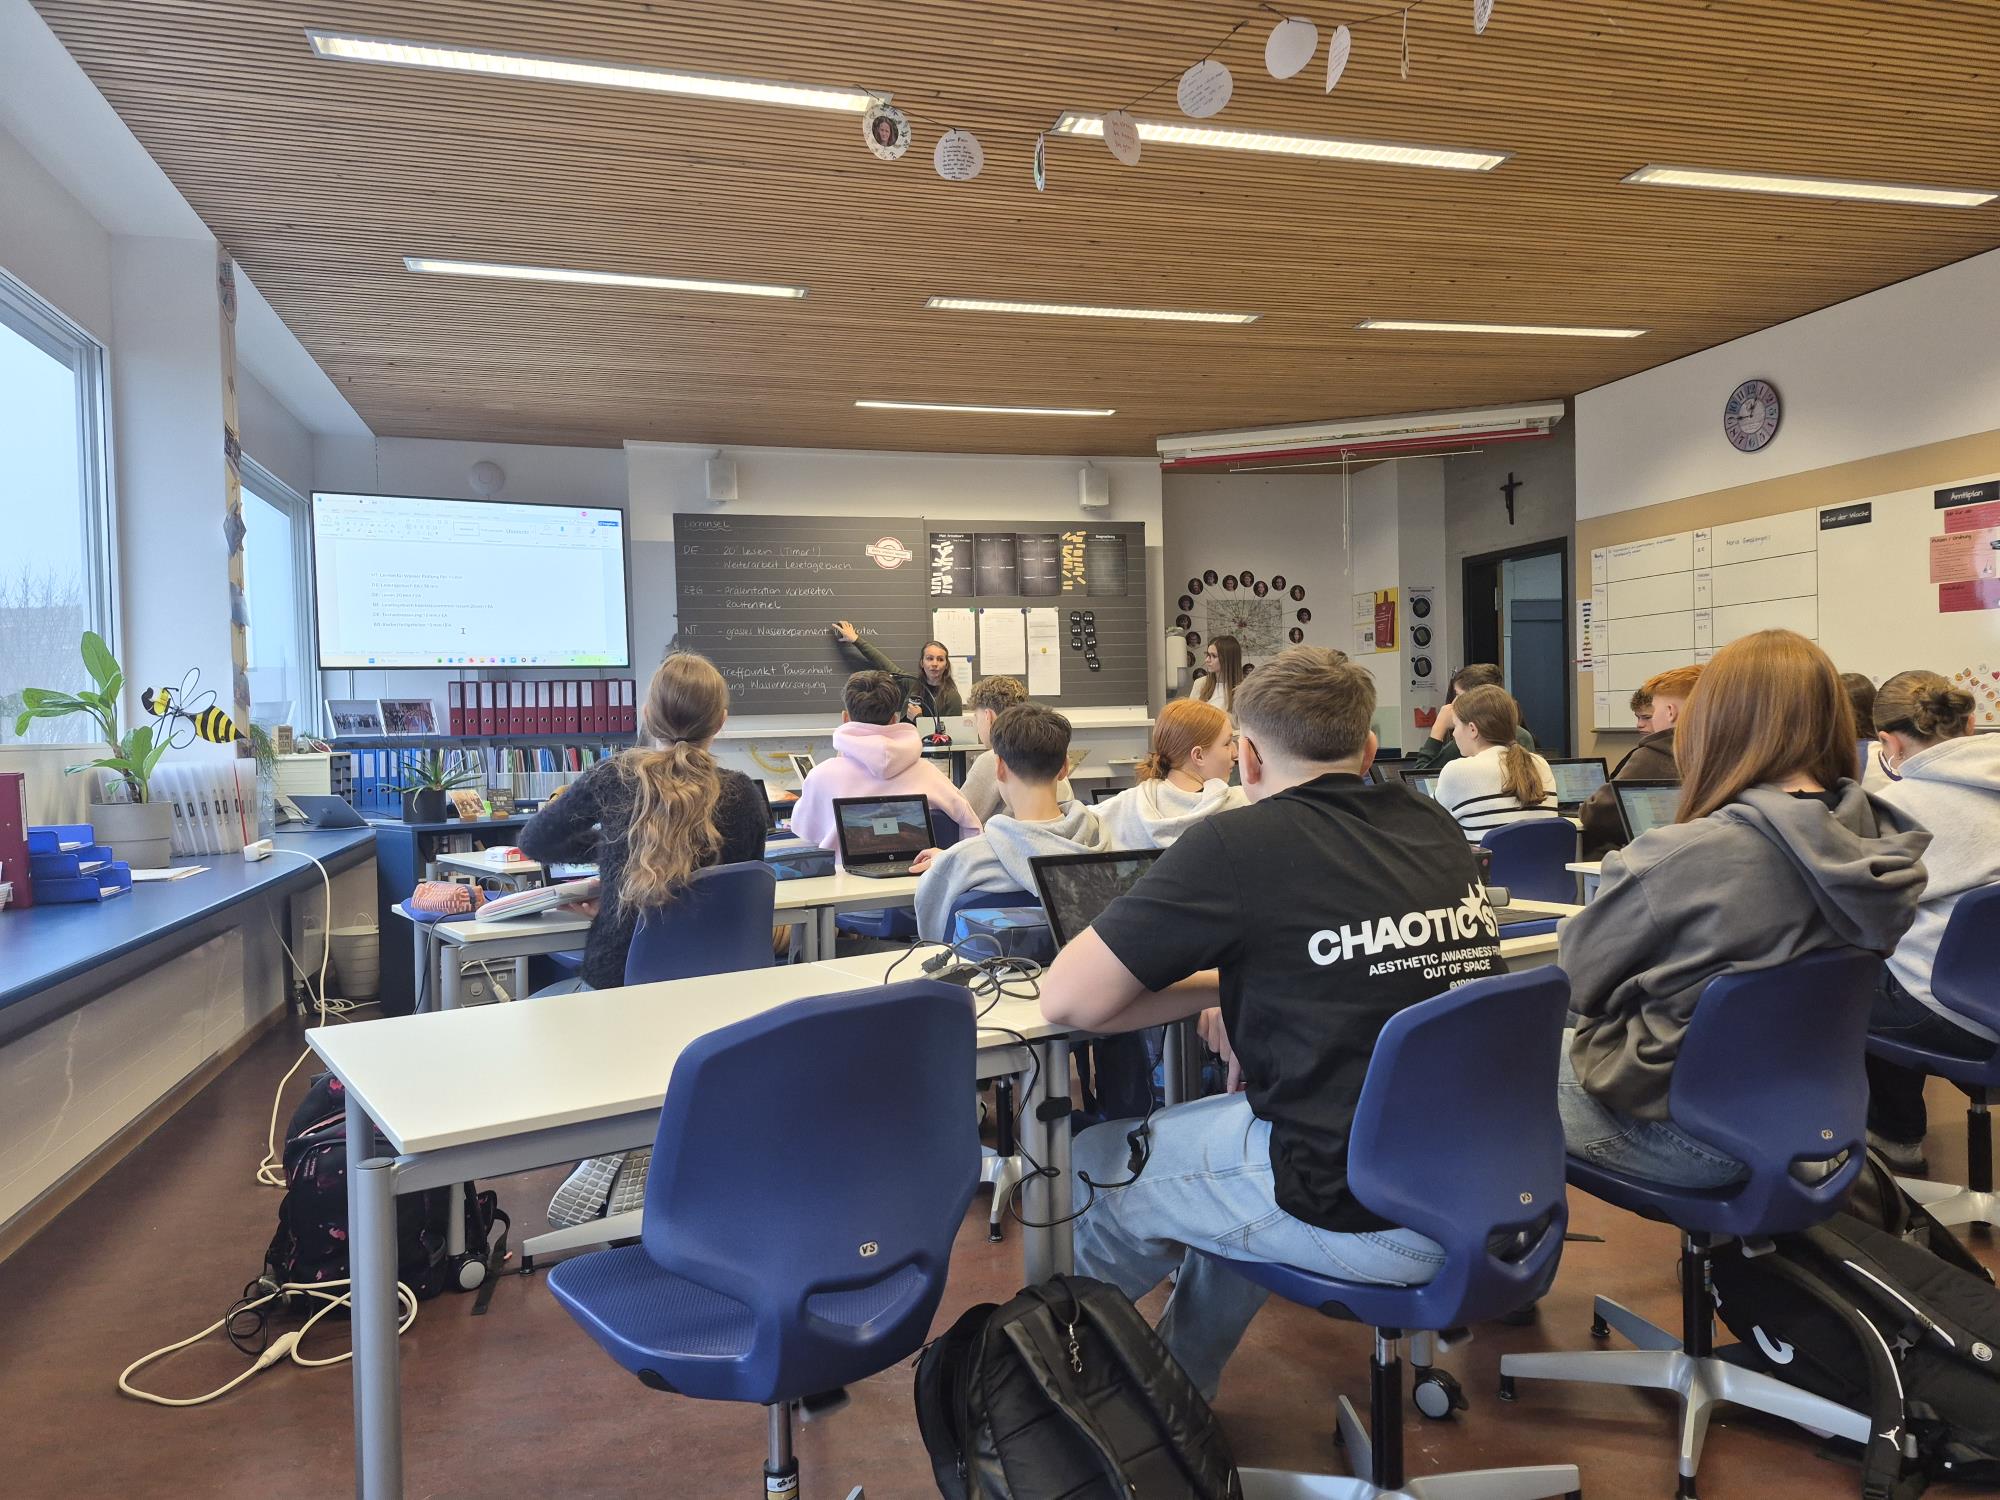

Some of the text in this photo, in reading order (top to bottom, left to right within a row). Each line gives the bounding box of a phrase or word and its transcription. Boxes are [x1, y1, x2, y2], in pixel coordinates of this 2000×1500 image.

[684, 624, 698, 635] NT
[1308, 904, 1477, 966] CHAOTIC
[1369, 953, 1439, 976] AESTHETIC
[1441, 945, 1493, 963] AWARENESS
[1423, 959, 1492, 980] OUT OF SPACE
[861, 1243, 876, 1255] VS
